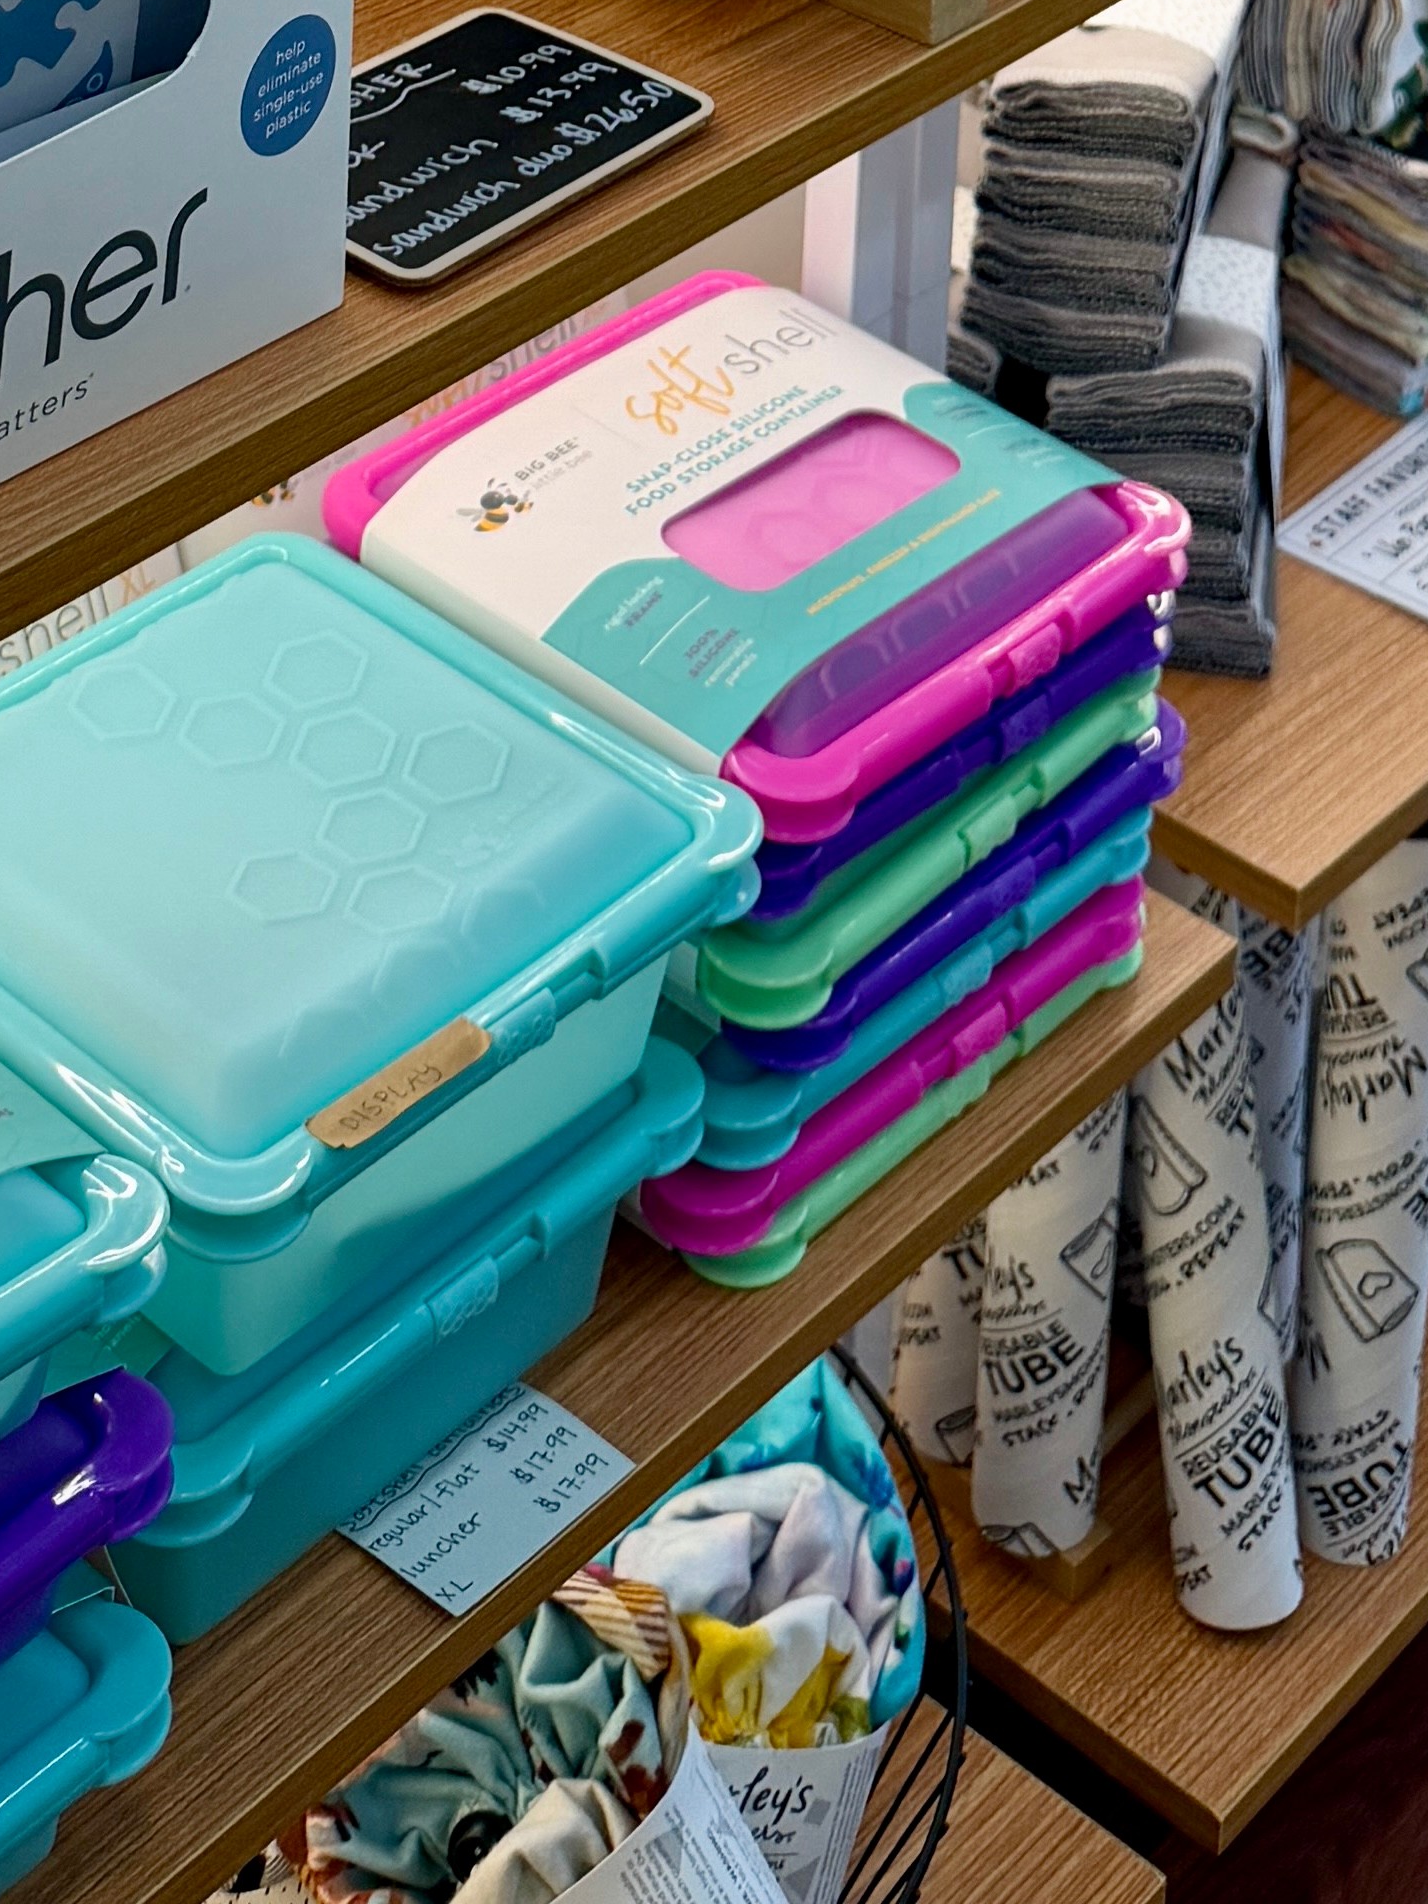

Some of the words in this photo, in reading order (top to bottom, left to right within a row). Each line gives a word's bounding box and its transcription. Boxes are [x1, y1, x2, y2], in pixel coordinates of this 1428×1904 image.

[460, 43, 574, 96] $10.99
[499, 61, 619, 125] $13.99
[373, 179, 522, 257] sandwich
[516, 144, 574, 177] duo
[624, 344, 737, 438] soft
[721, 306, 842, 377] shell
[513, 453, 548, 484] BIG
[544, 437, 578, 463] BEE
[623, 481, 679, 518] FOOD
[675, 435, 758, 488] STORAGE
[751, 384, 846, 440] CONTAINER
[624, 426, 735, 496] SNAP-CLOSE
[728, 383, 809, 431] SILICONE
[1312, 491, 1374, 542] STAFF
[338, 1064, 445, 1132] DISPLAY
[483, 1401, 550, 1455] $14.99
[1192, 1401, 1284, 1510] TUBE
[399, 1510, 483, 1580] luncher
[509, 1424, 579, 1486] $17.99
[434, 1578, 476, 1604] XL
[532, 1451, 611, 1515] $17.99
